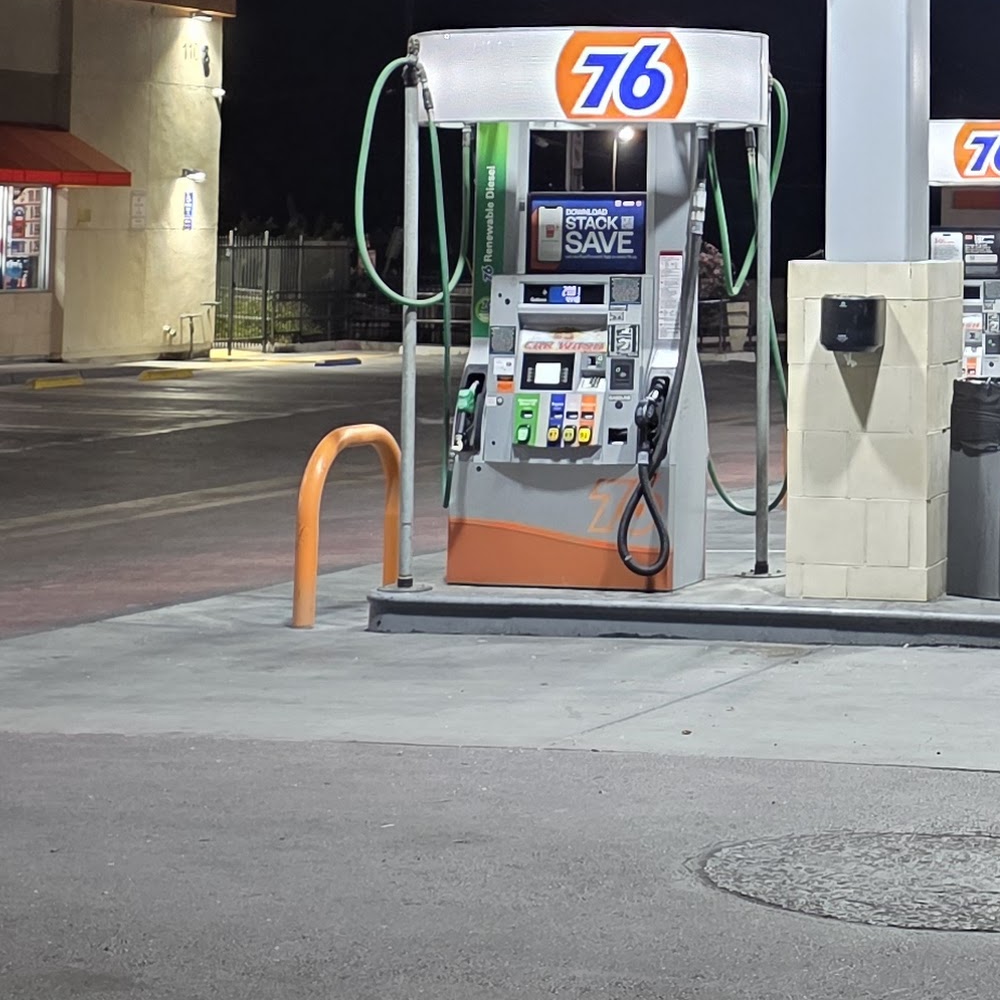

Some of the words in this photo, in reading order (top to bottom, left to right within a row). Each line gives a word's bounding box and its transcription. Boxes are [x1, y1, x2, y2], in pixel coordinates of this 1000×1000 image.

[571, 37, 674, 117] 76
[486, 165, 496, 199] Diesel
[484, 202, 495, 262] Renewable
[565, 215, 619, 230] STACK
[565, 231, 634, 254] SAVE
